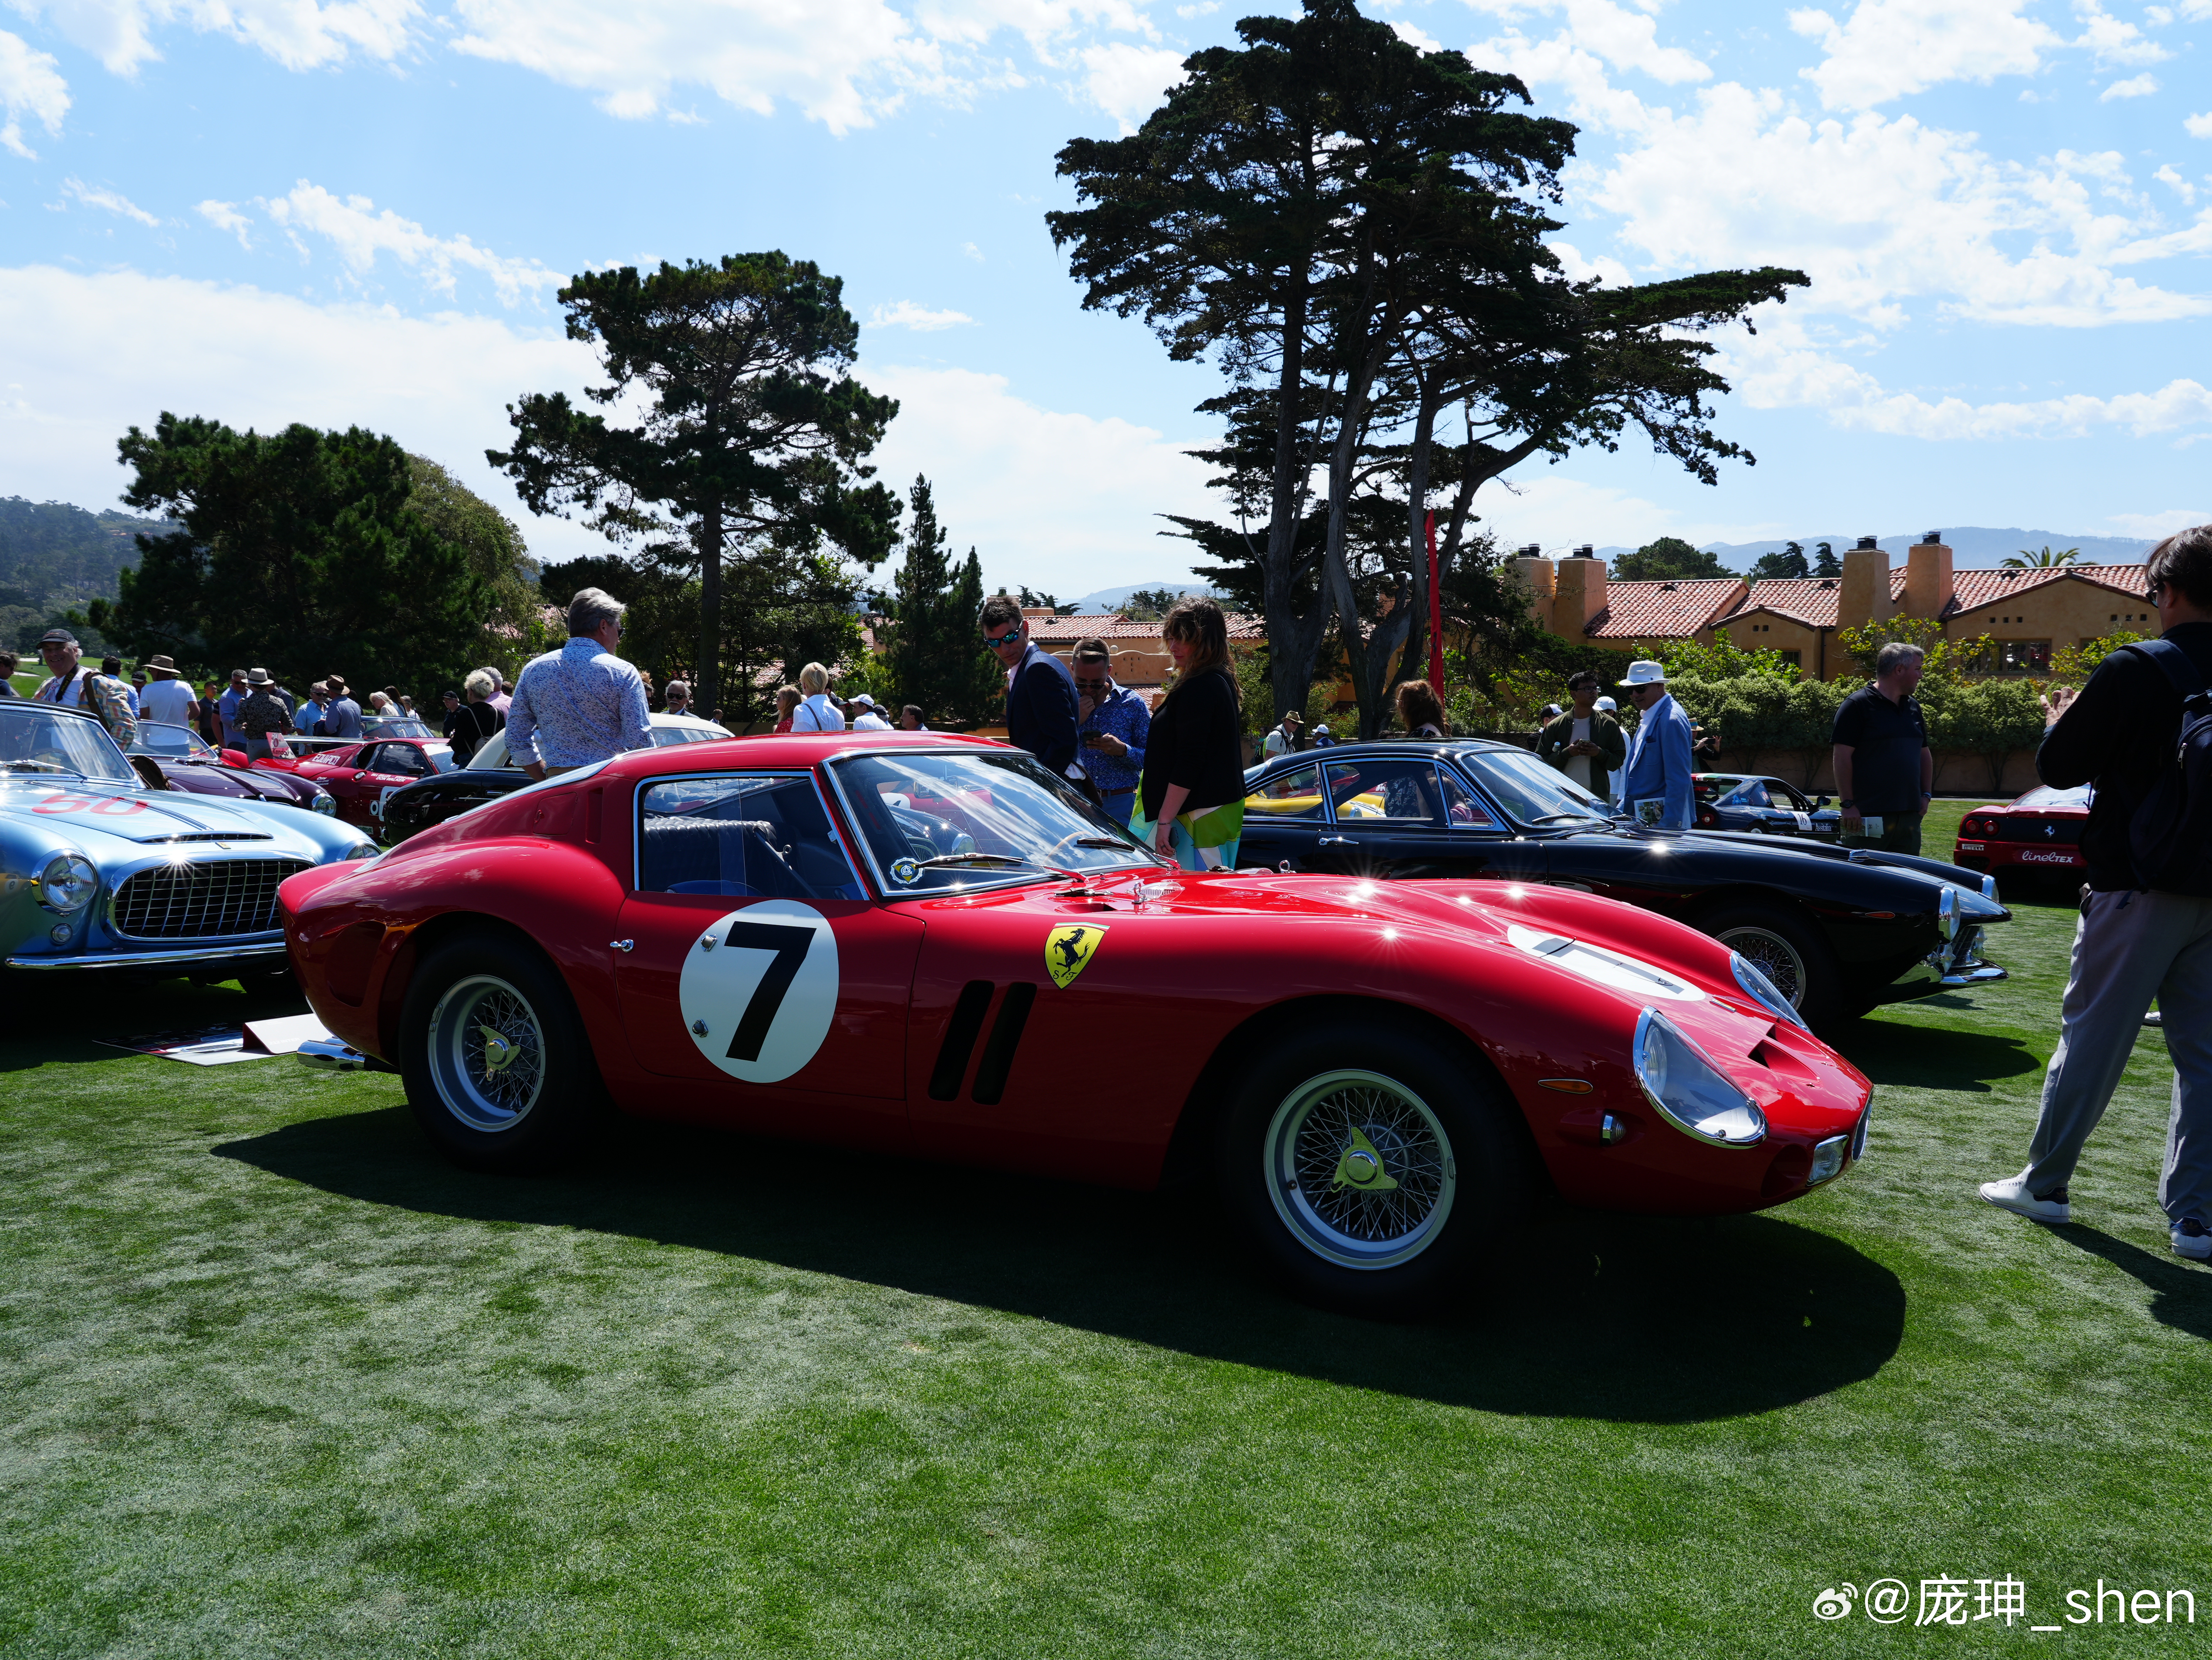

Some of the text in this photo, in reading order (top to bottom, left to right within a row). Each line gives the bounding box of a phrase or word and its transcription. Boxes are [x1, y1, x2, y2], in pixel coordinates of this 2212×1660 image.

[272, 748, 289, 756] Kendall
[31, 795, 150, 815] 50
[1798, 814, 1807, 825] 16
[1532, 938, 1685, 995] 7
[1053, 970, 1078, 980] S F
[724, 921, 817, 1062] 7
